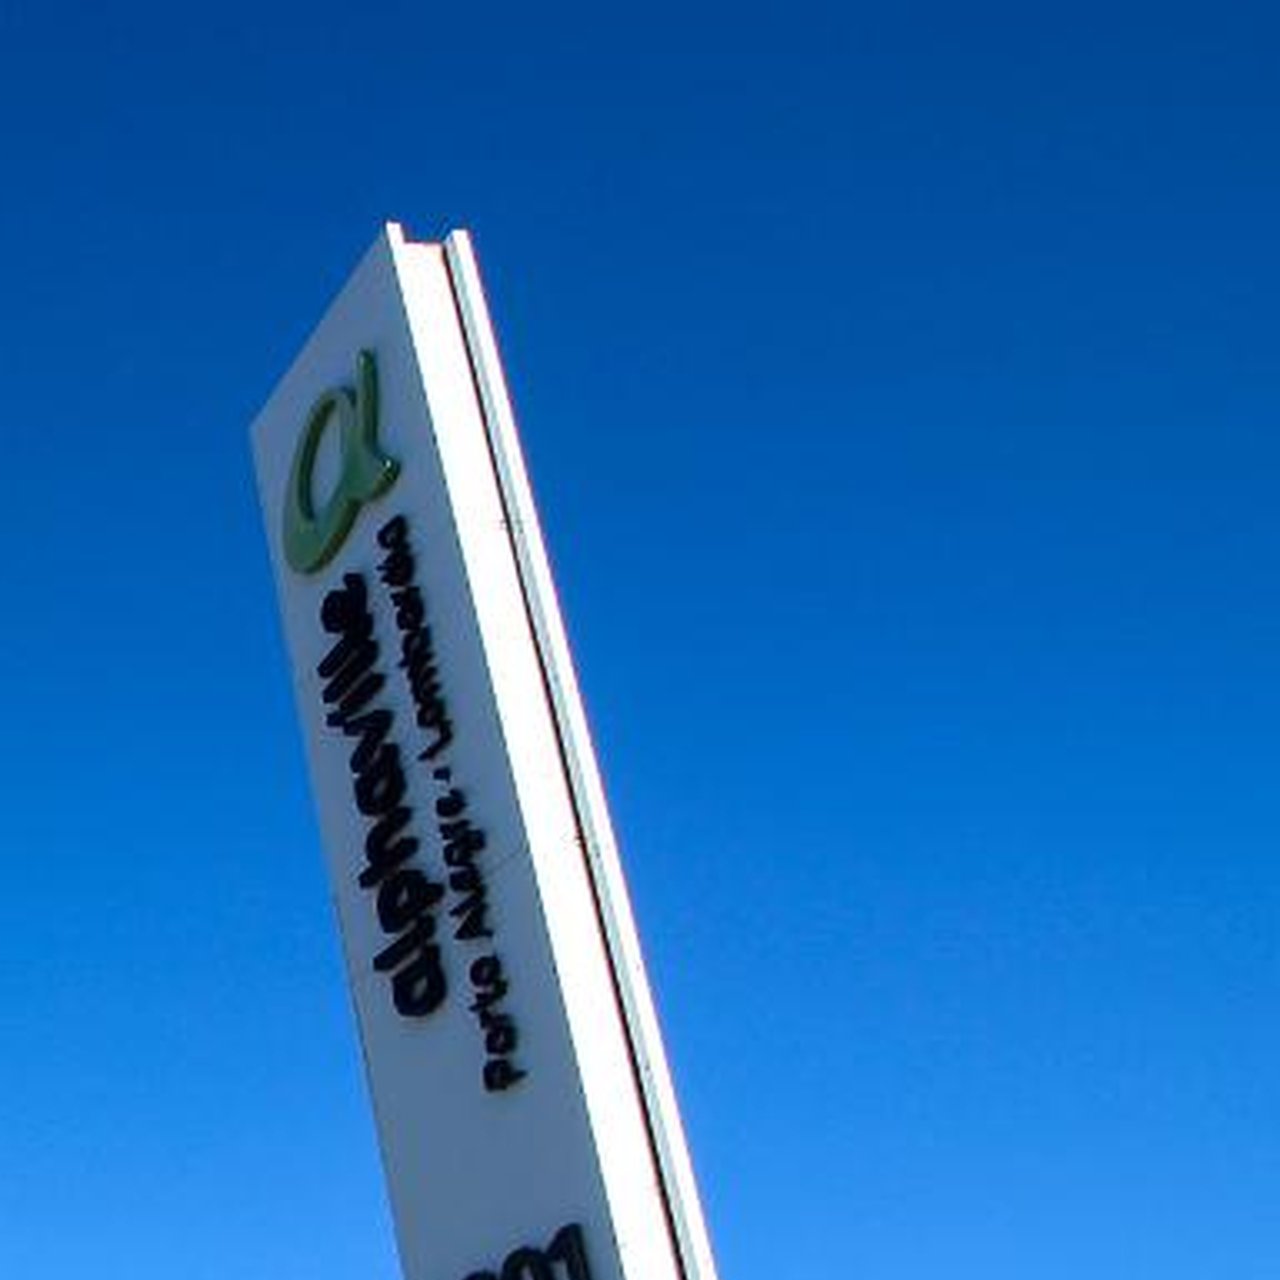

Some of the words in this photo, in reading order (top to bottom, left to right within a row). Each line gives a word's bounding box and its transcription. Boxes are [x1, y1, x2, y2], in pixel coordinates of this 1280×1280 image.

[317, 573, 446, 1017] alphaville
[436, 787, 495, 940] Alegre
[469, 954, 529, 1092] Porto
